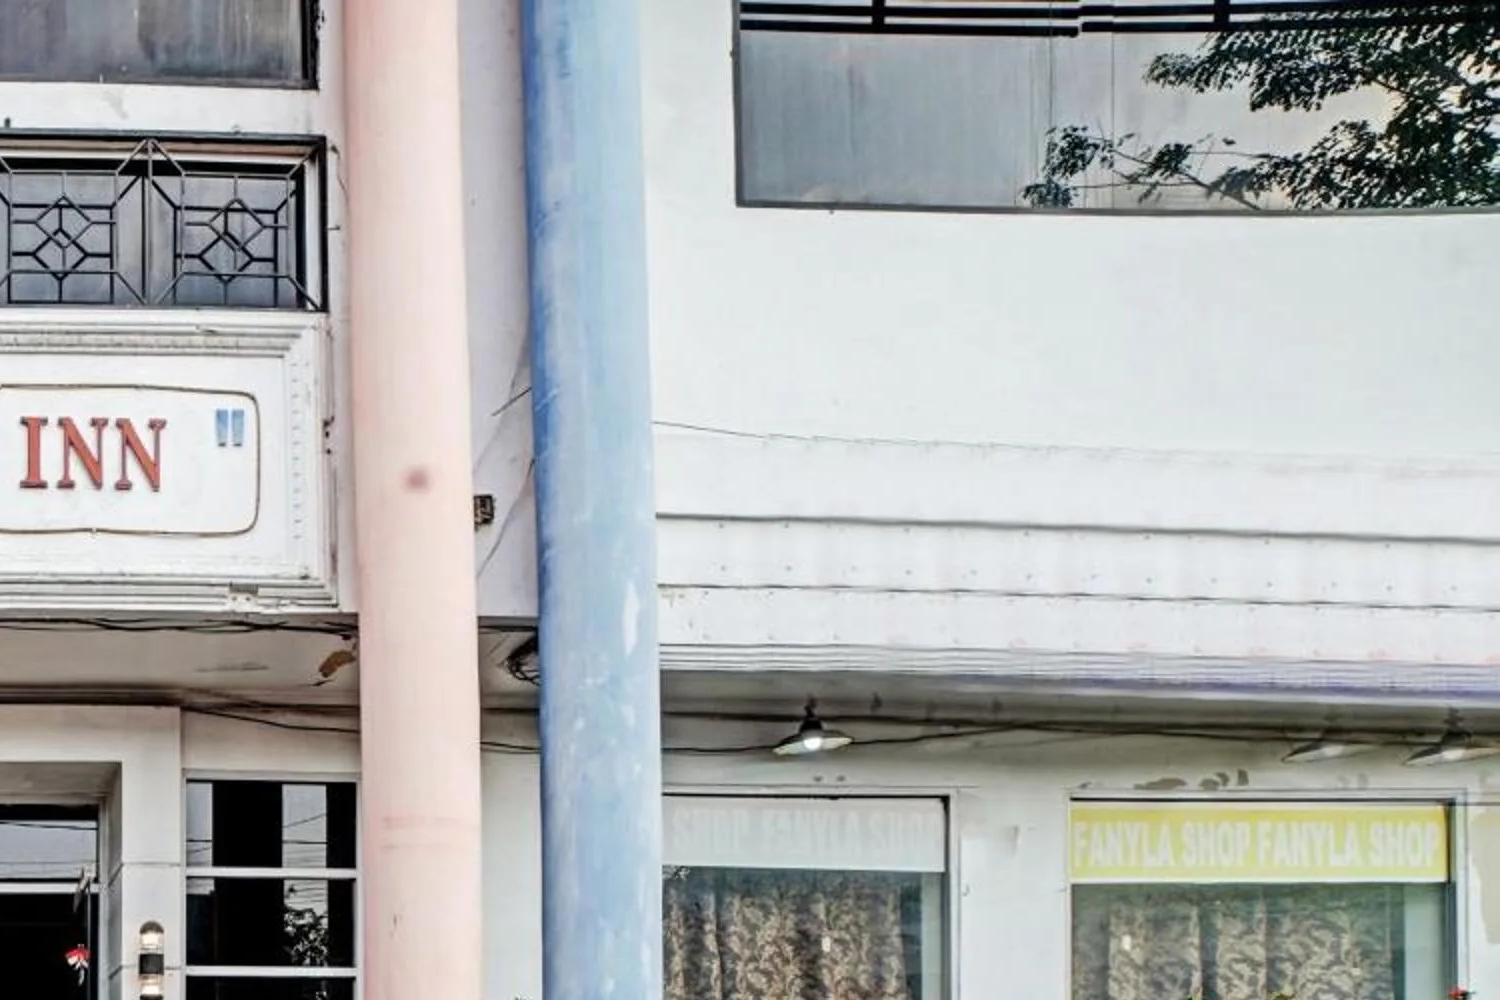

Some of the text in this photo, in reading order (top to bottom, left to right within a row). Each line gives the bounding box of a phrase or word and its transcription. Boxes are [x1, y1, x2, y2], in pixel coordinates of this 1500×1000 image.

[1073, 820, 1442, 868] FANYLA SHOP FANYLA SHOP
